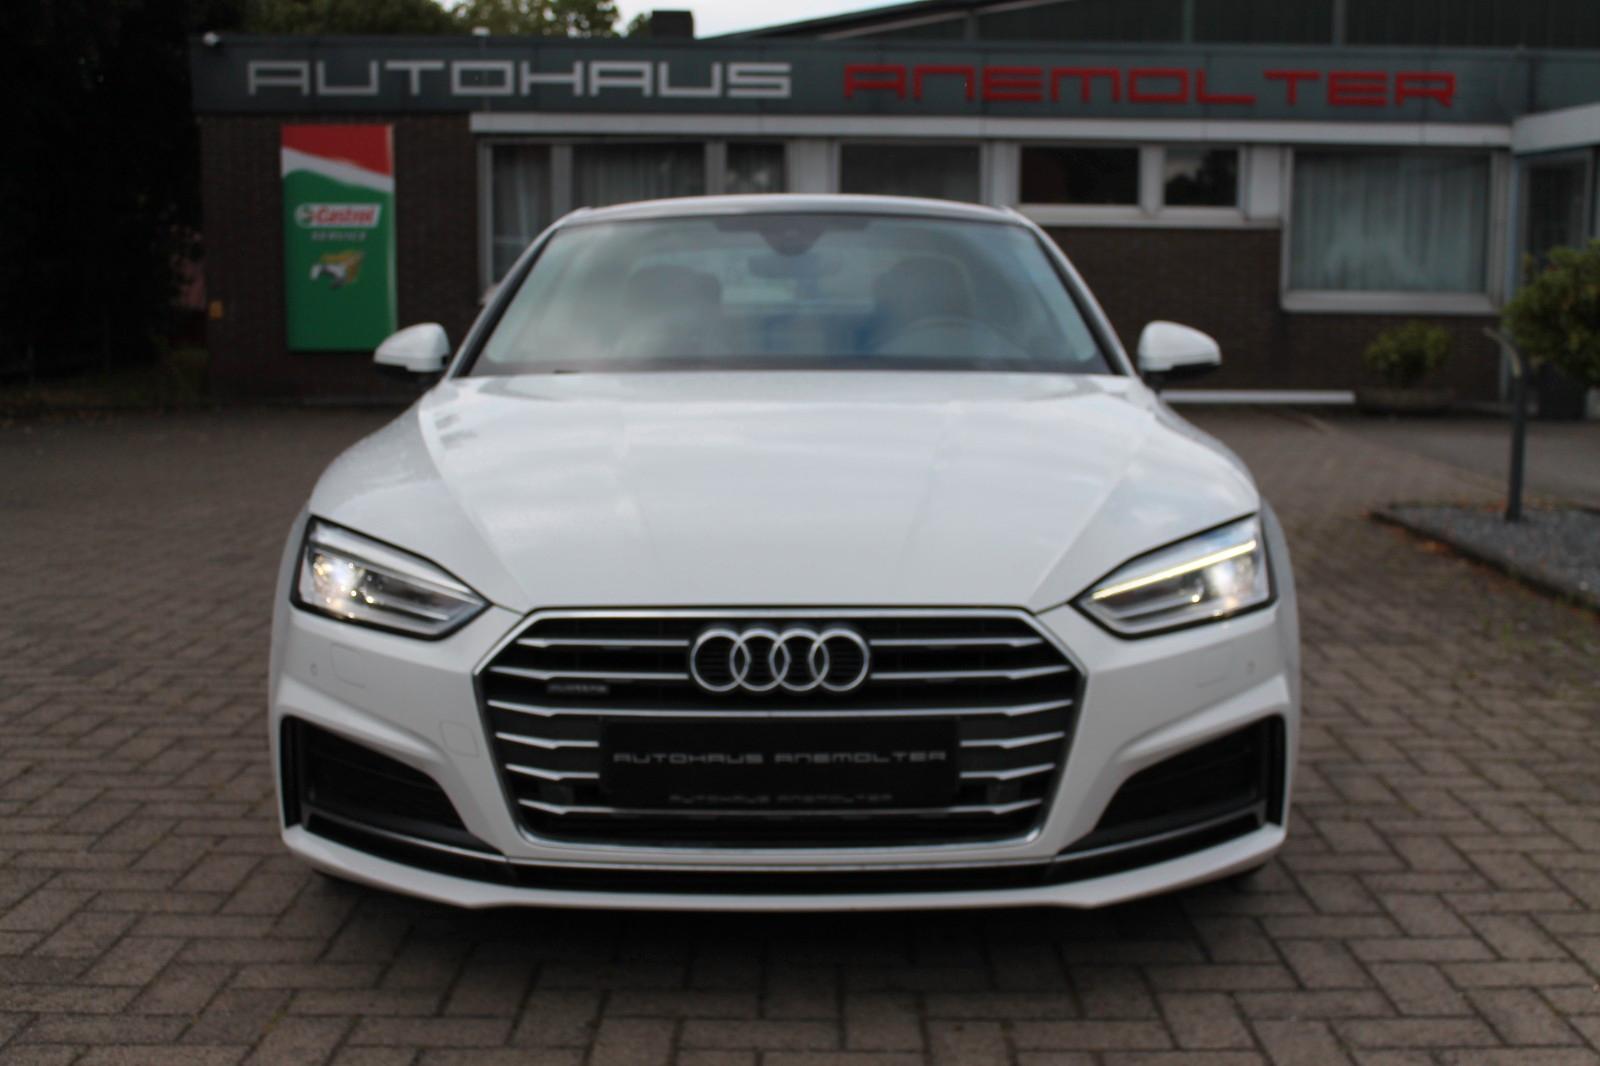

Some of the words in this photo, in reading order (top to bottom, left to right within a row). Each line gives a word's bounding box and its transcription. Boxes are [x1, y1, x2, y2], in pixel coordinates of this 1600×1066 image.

[247, 59, 792, 99] AUTOHAUS
[843, 64, 1455, 107] ANEMOLTER
[313, 206, 374, 224] Castrol
[613, 752, 764, 765] AUTOHAUS
[773, 750, 948, 765] ANEMOLTER
